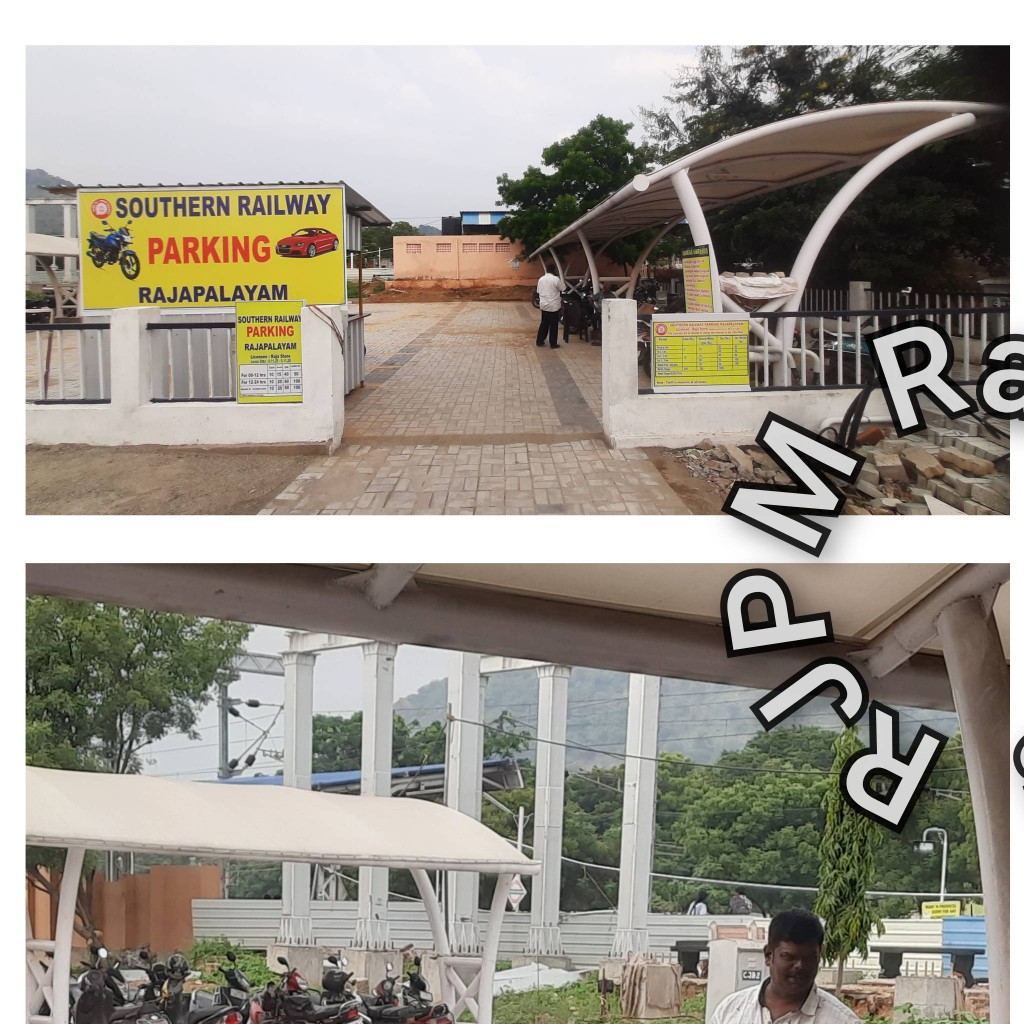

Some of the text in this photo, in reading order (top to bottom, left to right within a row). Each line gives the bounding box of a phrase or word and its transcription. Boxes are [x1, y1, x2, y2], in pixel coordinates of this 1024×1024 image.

[116, 194, 332, 218] SOUTHERN RAILWAY
[148, 235, 271, 264] PARKING
[138, 284, 288, 303] RAJAPALAYAM
[237, 315, 273, 324] SOUTHERN
[246, 325, 295, 338] PARKING
[244, 342, 297, 351] RAJAPALAYAM
